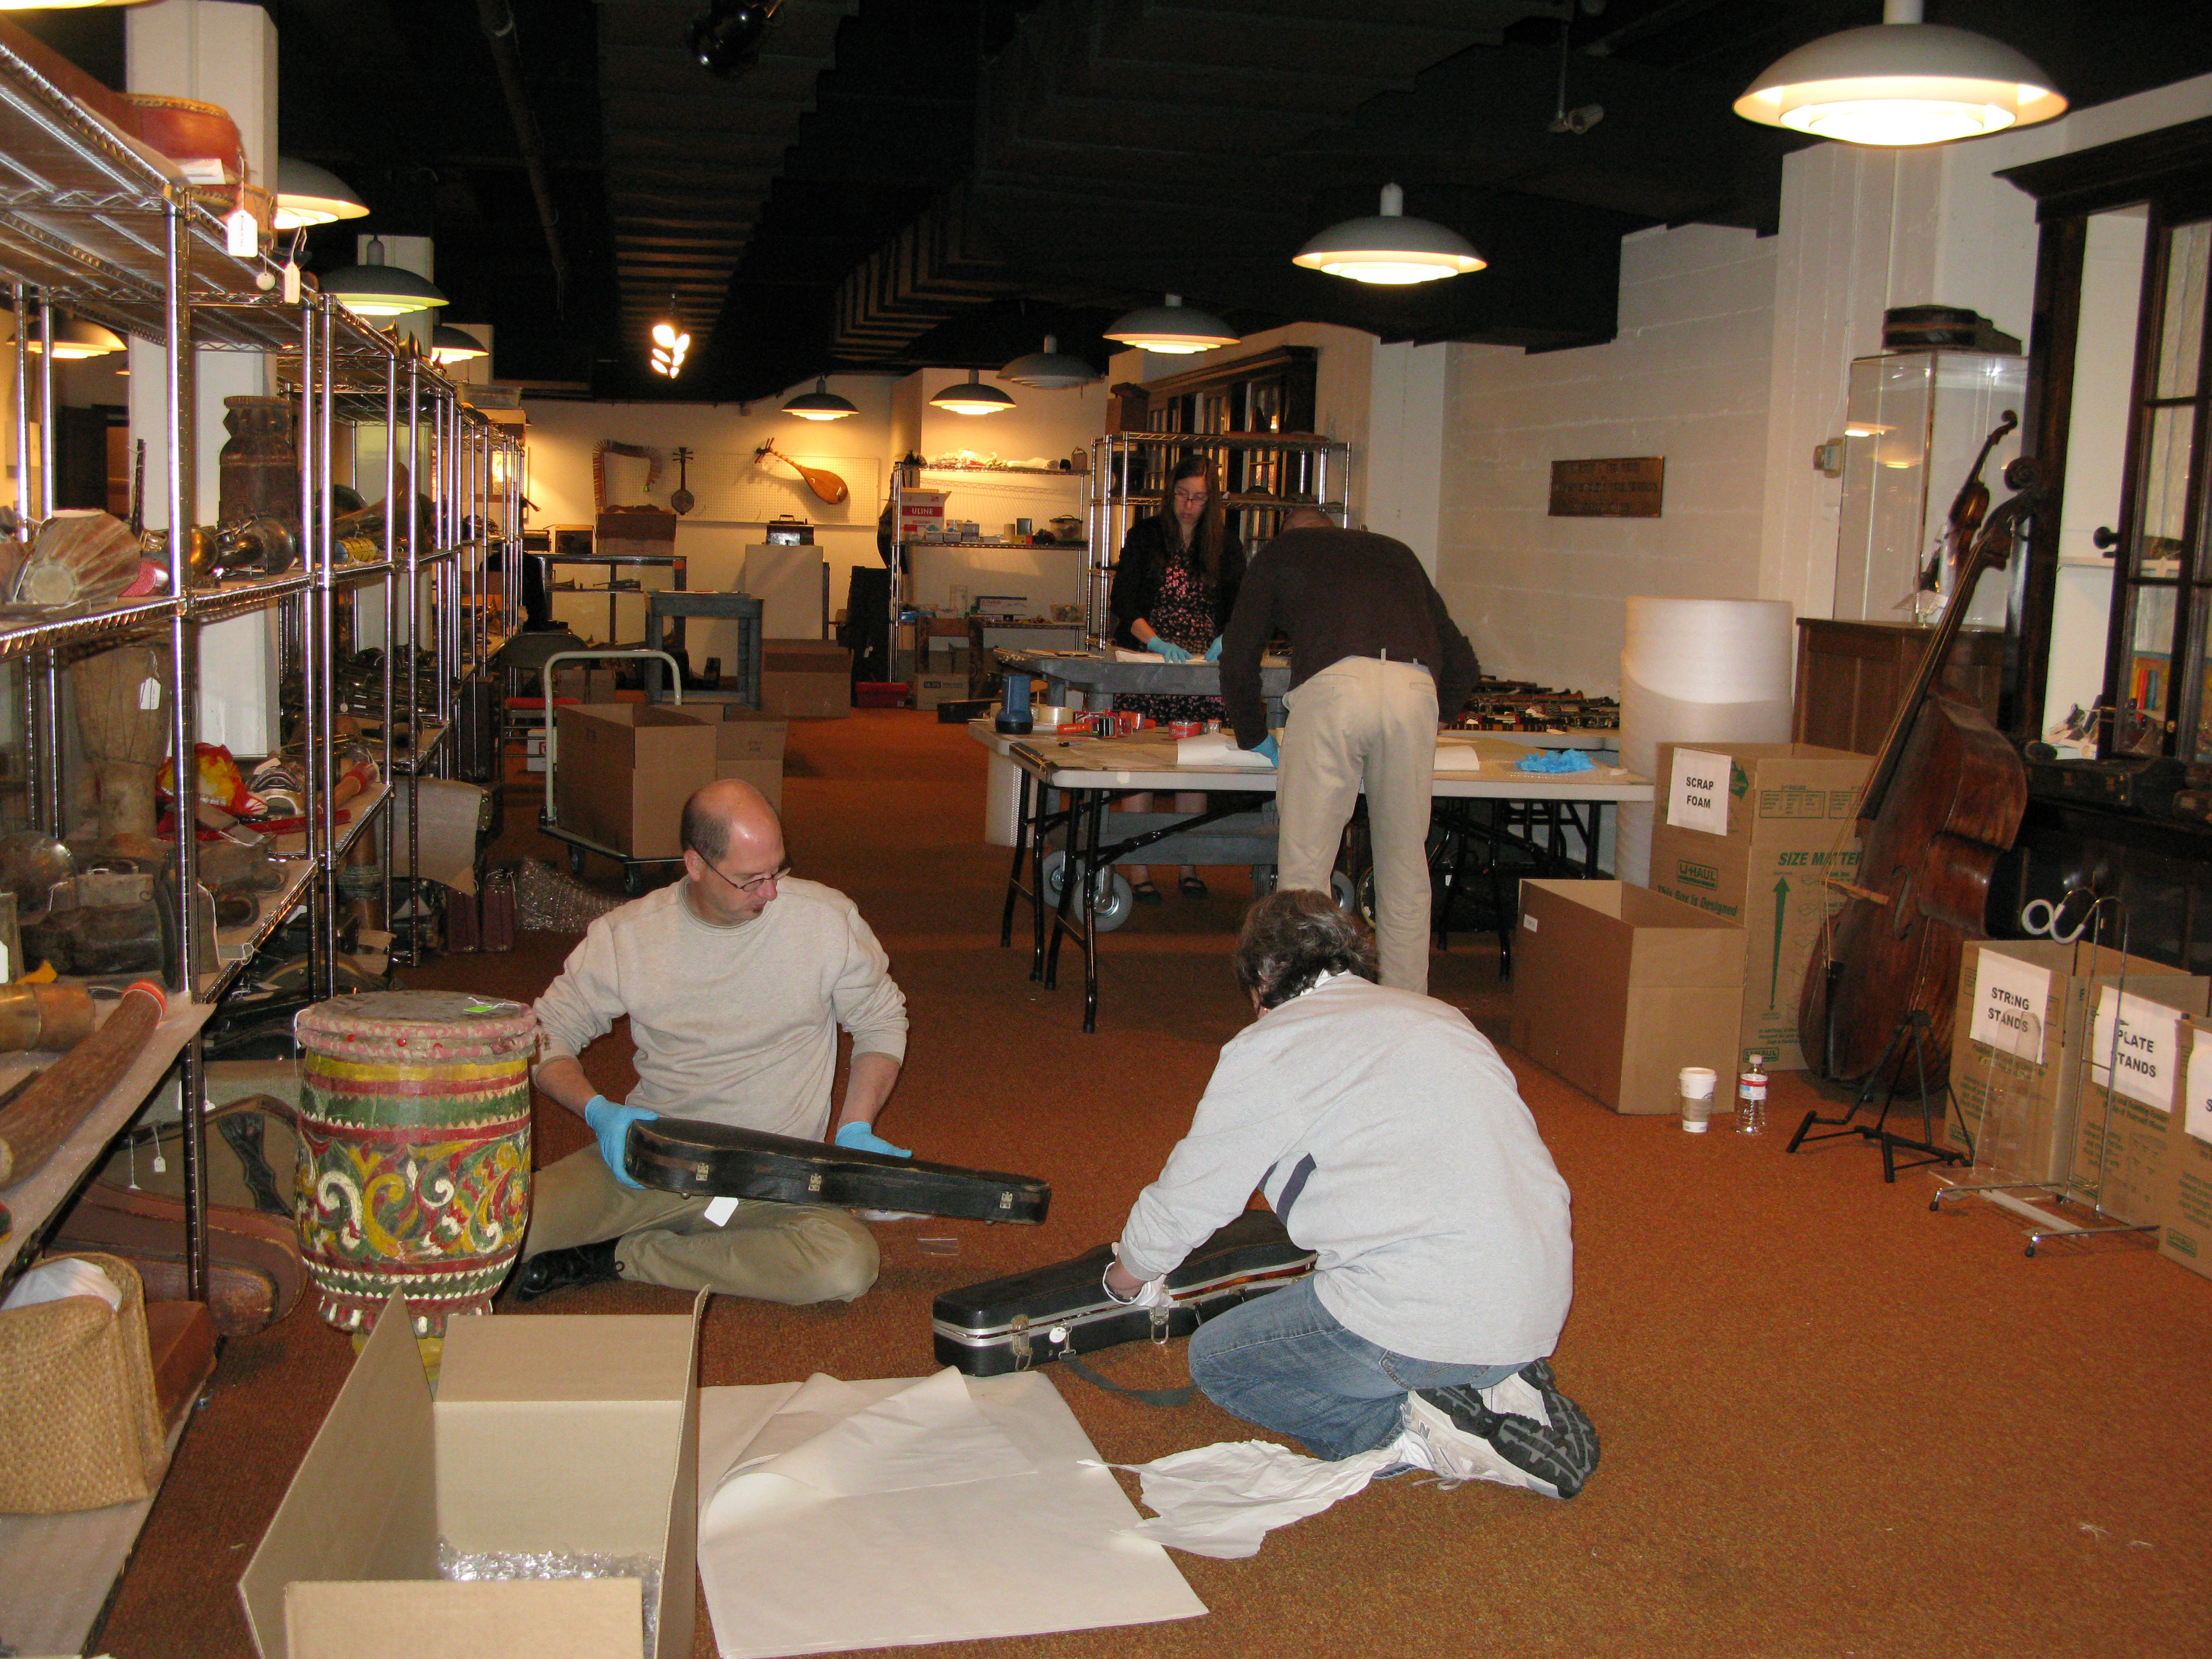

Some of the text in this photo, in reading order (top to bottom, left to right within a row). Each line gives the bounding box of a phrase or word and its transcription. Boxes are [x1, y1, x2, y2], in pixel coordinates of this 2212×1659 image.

[1686, 776, 1714, 791] SCRAP
[1687, 795, 1711, 808] FOAM
[1778, 852, 1809, 866] SIZE
[1675, 890, 1689, 903] Box
[1691, 894, 1698, 906] is
[1700, 896, 1739, 916] Designed
[1991, 987, 2030, 1010] STRING
[1987, 1007, 2028, 1032] STANDS
[2117, 1051, 2156, 1078] TANDS
